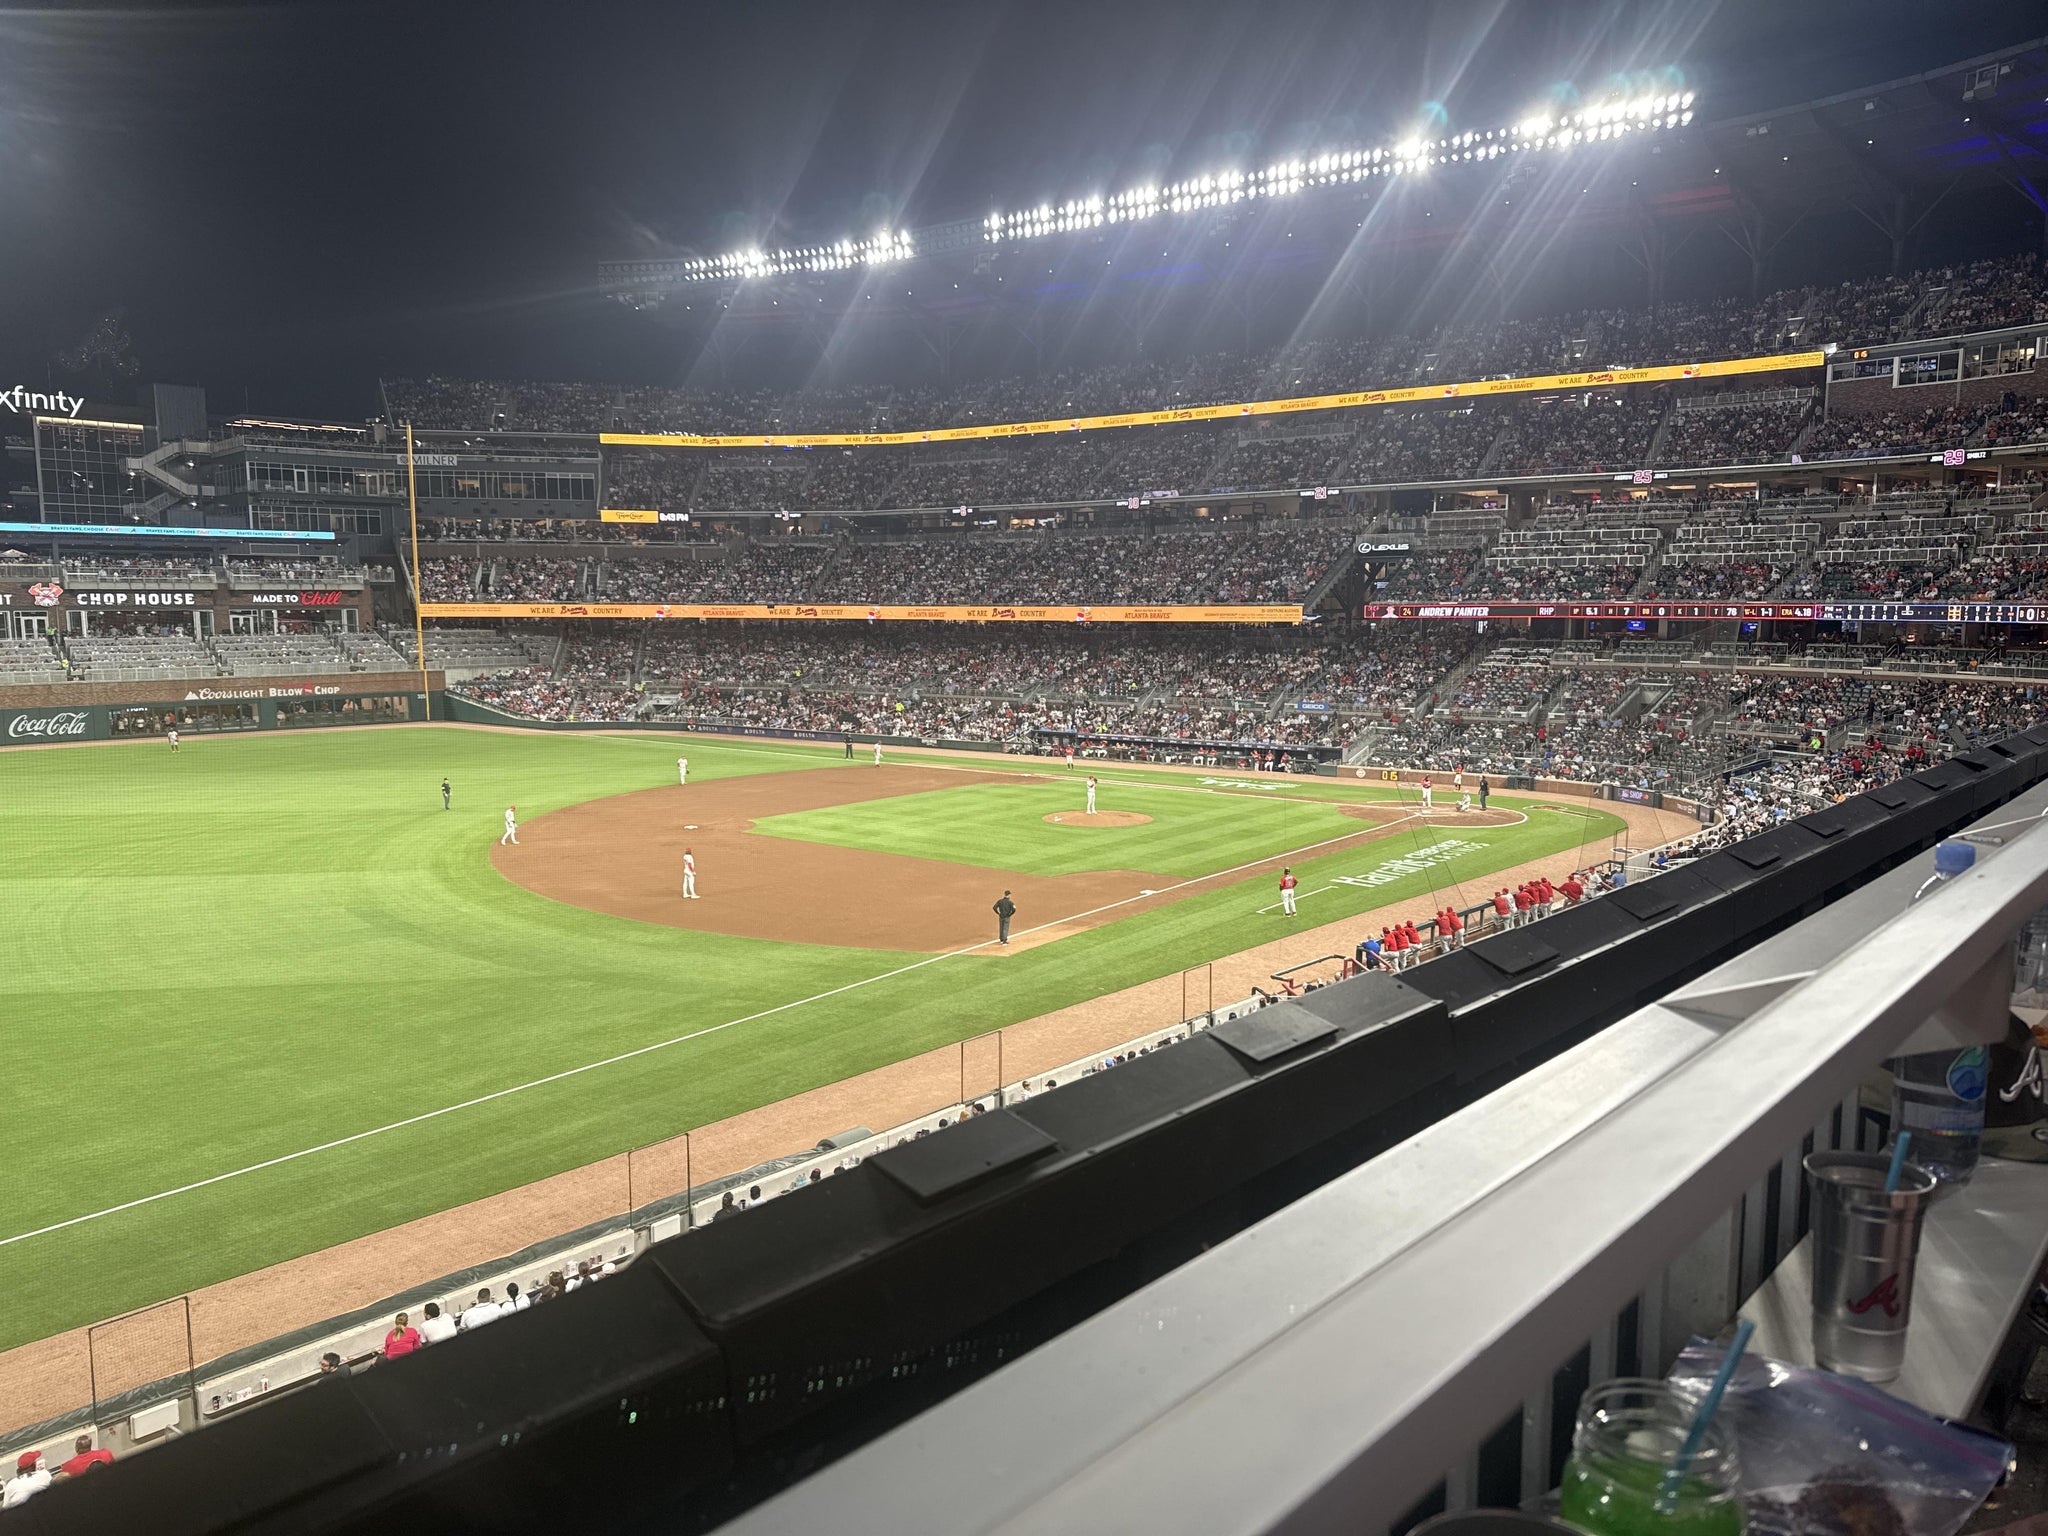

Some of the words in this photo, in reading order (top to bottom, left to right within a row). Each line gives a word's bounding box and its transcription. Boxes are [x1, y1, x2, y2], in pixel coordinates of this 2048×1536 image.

[1570, 376, 1582, 384] ARE
[1619, 372, 1648, 380] COUNTRY
[0, 385, 84, 417] xfinity
[1390, 391, 1415, 399] COUNTRY
[412, 456, 454, 465] MILNER
[1944, 449, 1965, 466] 29
[1634, 470, 1653, 484] 25
[1314, 487, 1327, 499] 21
[77, 593, 127, 605] CHOP
[135, 594, 195, 605] HOUSE
[253, 594, 282, 603] MADE
[285, 594, 298, 603] TO
[300, 591, 342, 605] Chill
[560, 606, 588, 615] Braves
[1403, 608, 1411, 616] 24
[1419, 607, 1452, 616] ANDREW
[1454, 607, 1489, 616] PAINTER
[1539, 608, 1554, 616] RHP
[1761, 608, 1772, 616] 1-1
[2026, 608, 2034, 621] 0
[199, 688, 232, 700] Coors
[234, 689, 263, 698] LIGHT
[269, 688, 302, 697] BELOW
[314, 686, 340, 694] CHOP
[8, 712, 89, 737] Coca-Cola
